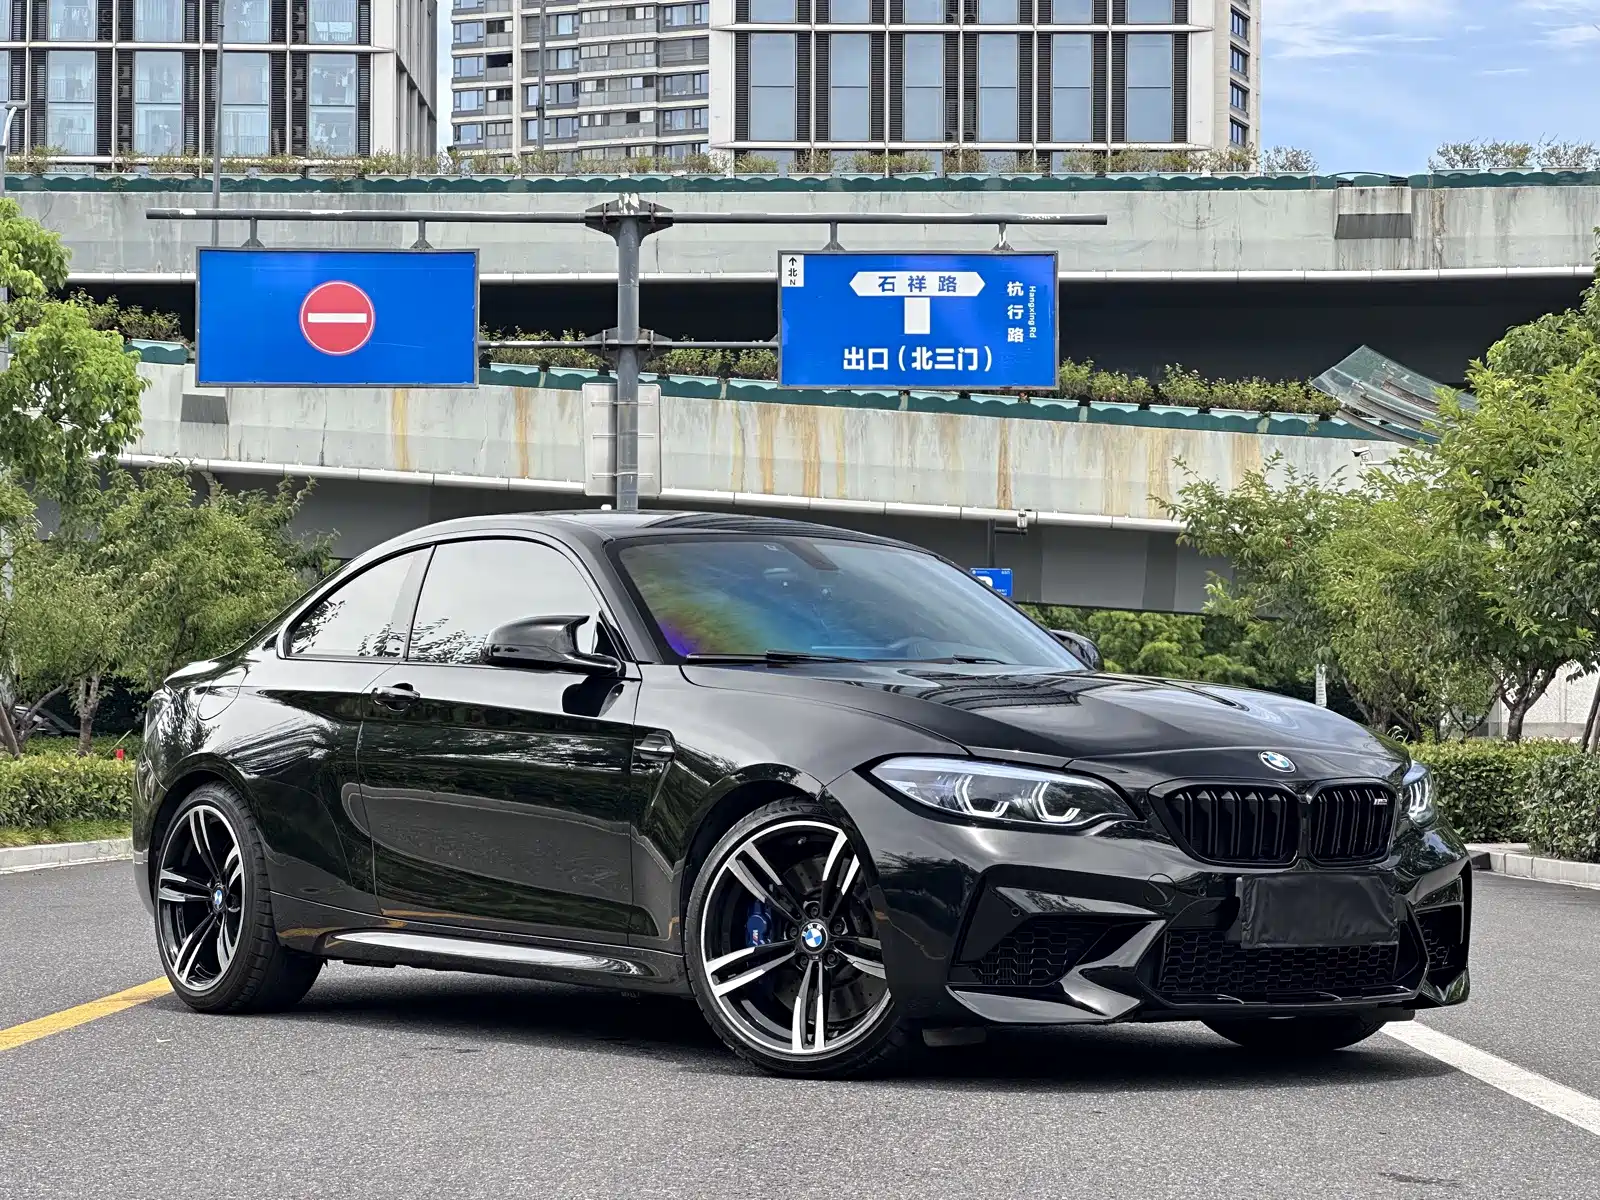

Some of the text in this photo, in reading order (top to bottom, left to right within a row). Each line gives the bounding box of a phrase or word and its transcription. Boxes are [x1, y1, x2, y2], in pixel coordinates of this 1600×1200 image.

[788, 268, 798, 277] 北
[878, 275, 957, 293] 石祥路
[1006, 281, 1024, 343] 杭行路
[1028, 285, 1037, 338] Hangxing Rd
